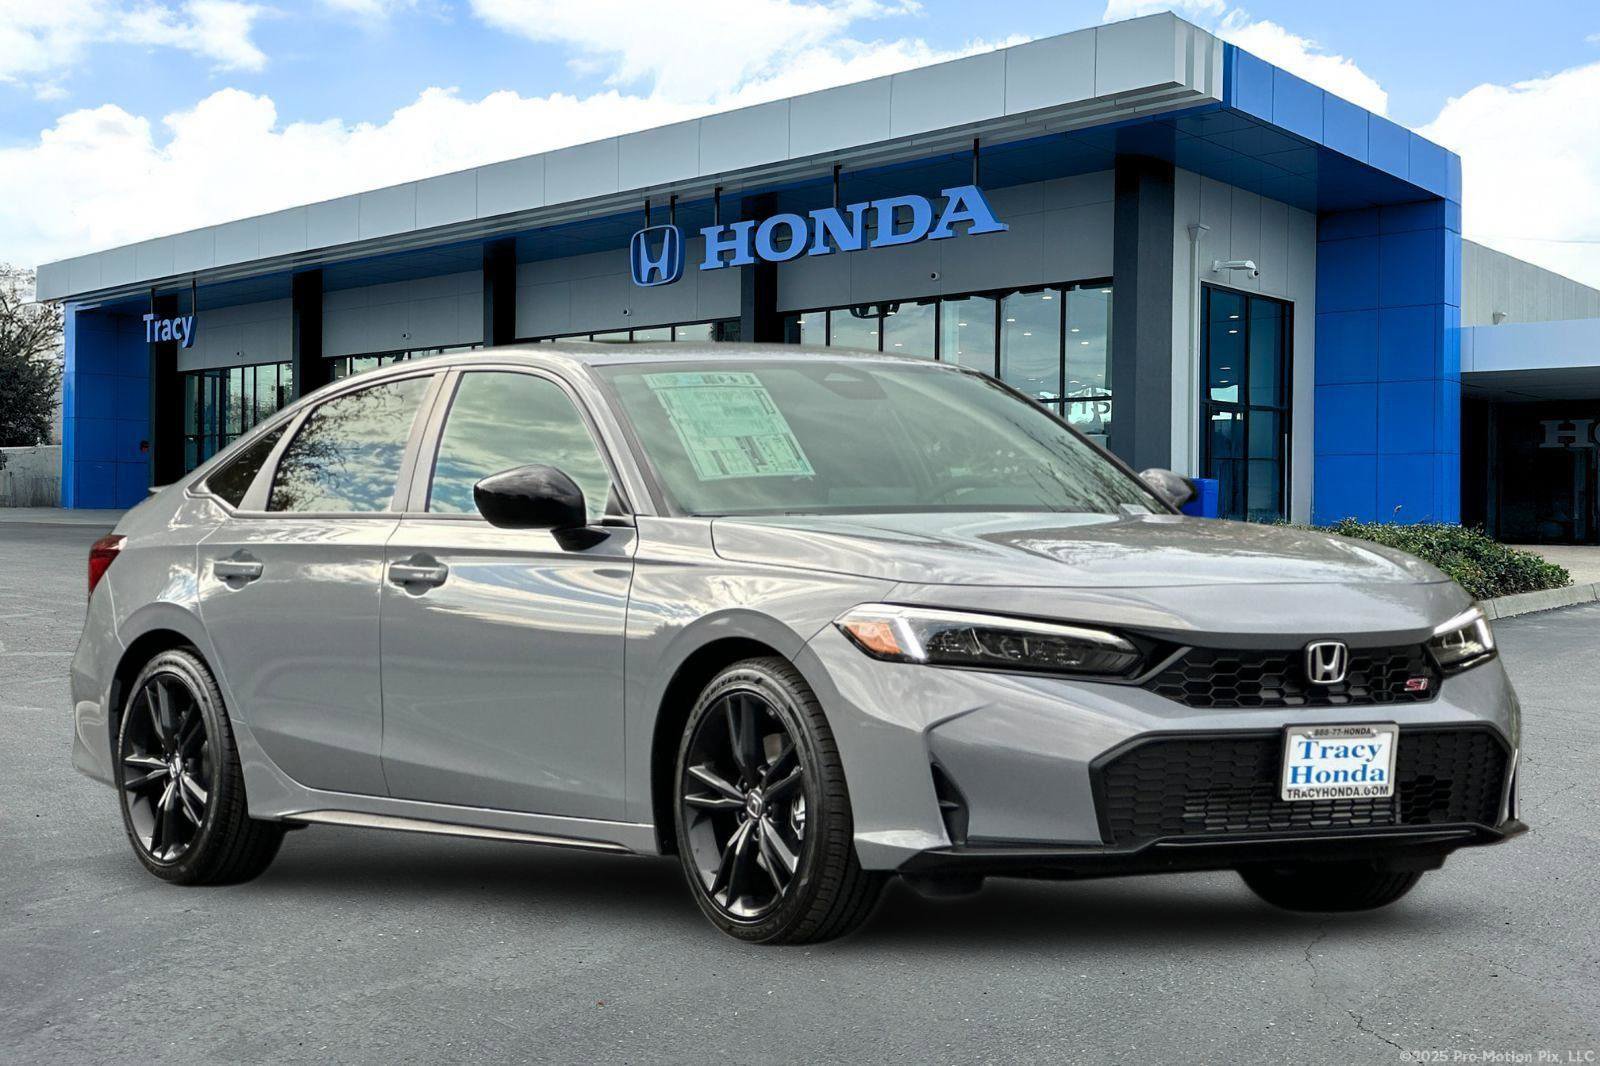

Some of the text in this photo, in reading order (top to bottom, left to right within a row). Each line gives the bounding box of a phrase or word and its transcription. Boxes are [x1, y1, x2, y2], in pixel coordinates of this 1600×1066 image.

[700, 184, 1009, 271] HONDA
[142, 313, 194, 349] Tracy
[1539, 419, 1600, 448] H
[1297, 740, 1383, 763] Tracy
[1290, 763, 1386, 785] Honda
[1287, 786, 1389, 798] TRACYHONDA.COM
